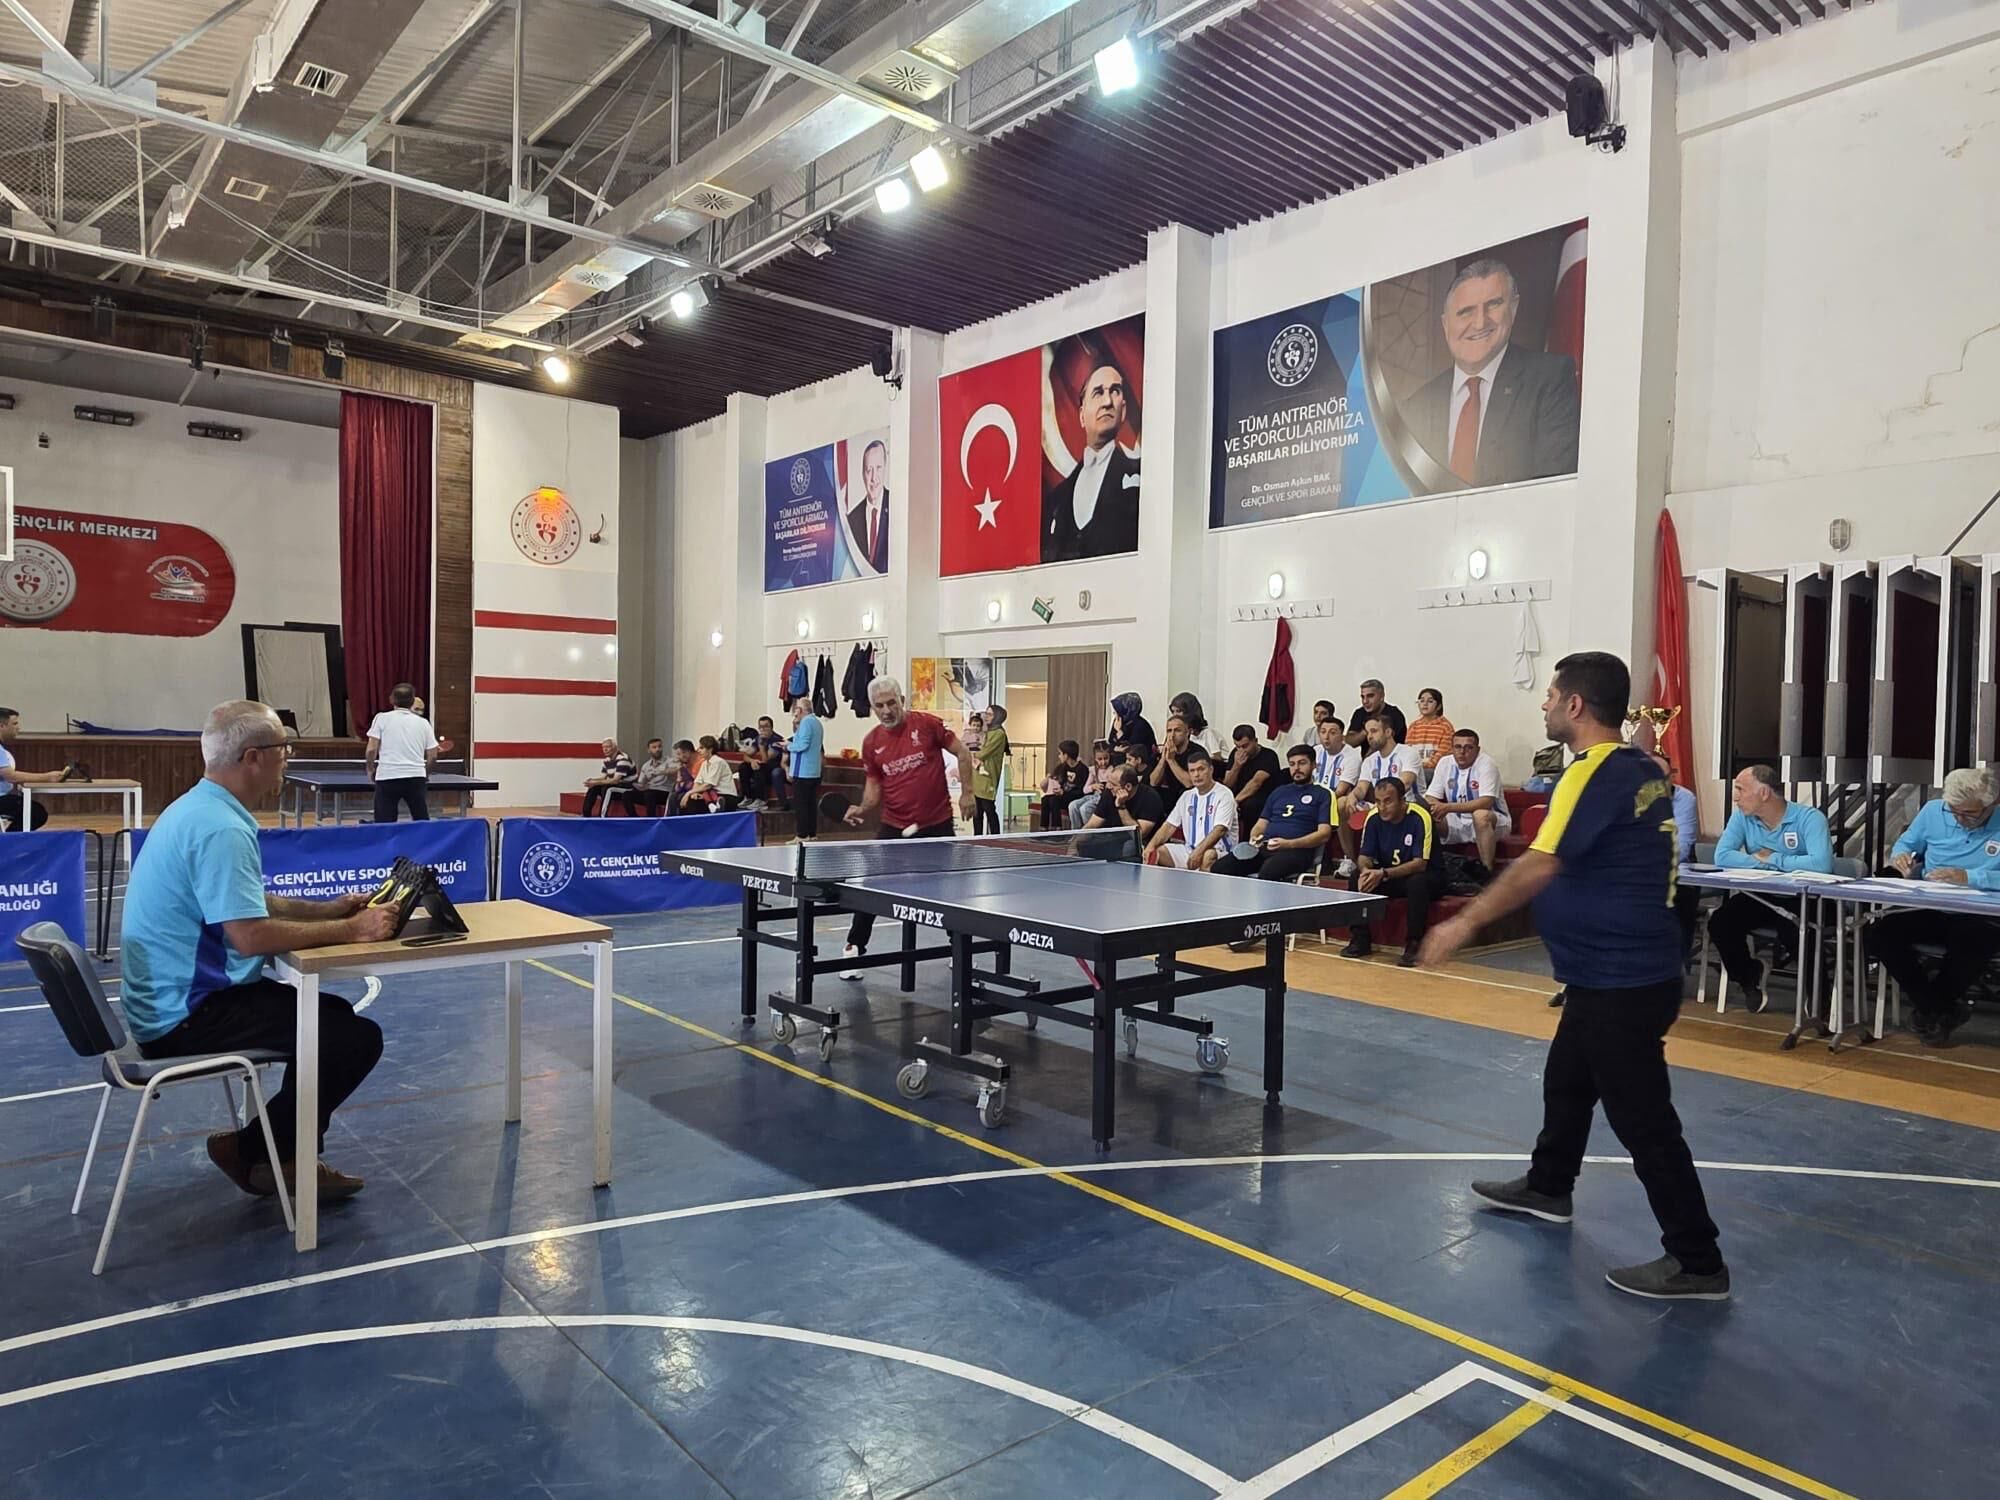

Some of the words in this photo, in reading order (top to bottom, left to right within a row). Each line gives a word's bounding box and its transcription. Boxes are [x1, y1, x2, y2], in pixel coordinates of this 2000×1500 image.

[1239, 415, 1268, 434] TÜM
[1271, 397, 1348, 428] ANTRENÖR
[1224, 437, 1240, 454] VE
[1242, 411, 1364, 450] SPORCULARIMIZA
[1228, 446, 1289, 469] BAŞARILAR
[1291, 432, 1359, 456] DİLİYORUM
[1251, 485, 1262, 494] Dr.
[1263, 481, 1289, 492] Osman
[13, 514, 75, 532] ENÇLİK
[80, 521, 158, 541] MERKEZİ
[1281, 804, 1295, 818] 3
[581, 857, 600, 868] T.C.
[601, 854, 643, 869] GENÇLİK
[644, 854, 659, 865] VE
[1392, 849, 1401, 865] 5
[273, 869, 336, 886] GENÇLİK
[337, 869, 356, 882] VE
[742, 875, 780, 893] VERTEX
[0, 880, 58, 897] ANLIĞI
[303, 885, 345, 898] GENÇLİK
[361, 883, 380, 892] SPO
[0, 899, 41, 912] RLÜĞÜ
[892, 903, 944, 927] VERTEX
[1253, 922, 1281, 937] DELTA
[1020, 930, 1054, 950] DELTA
